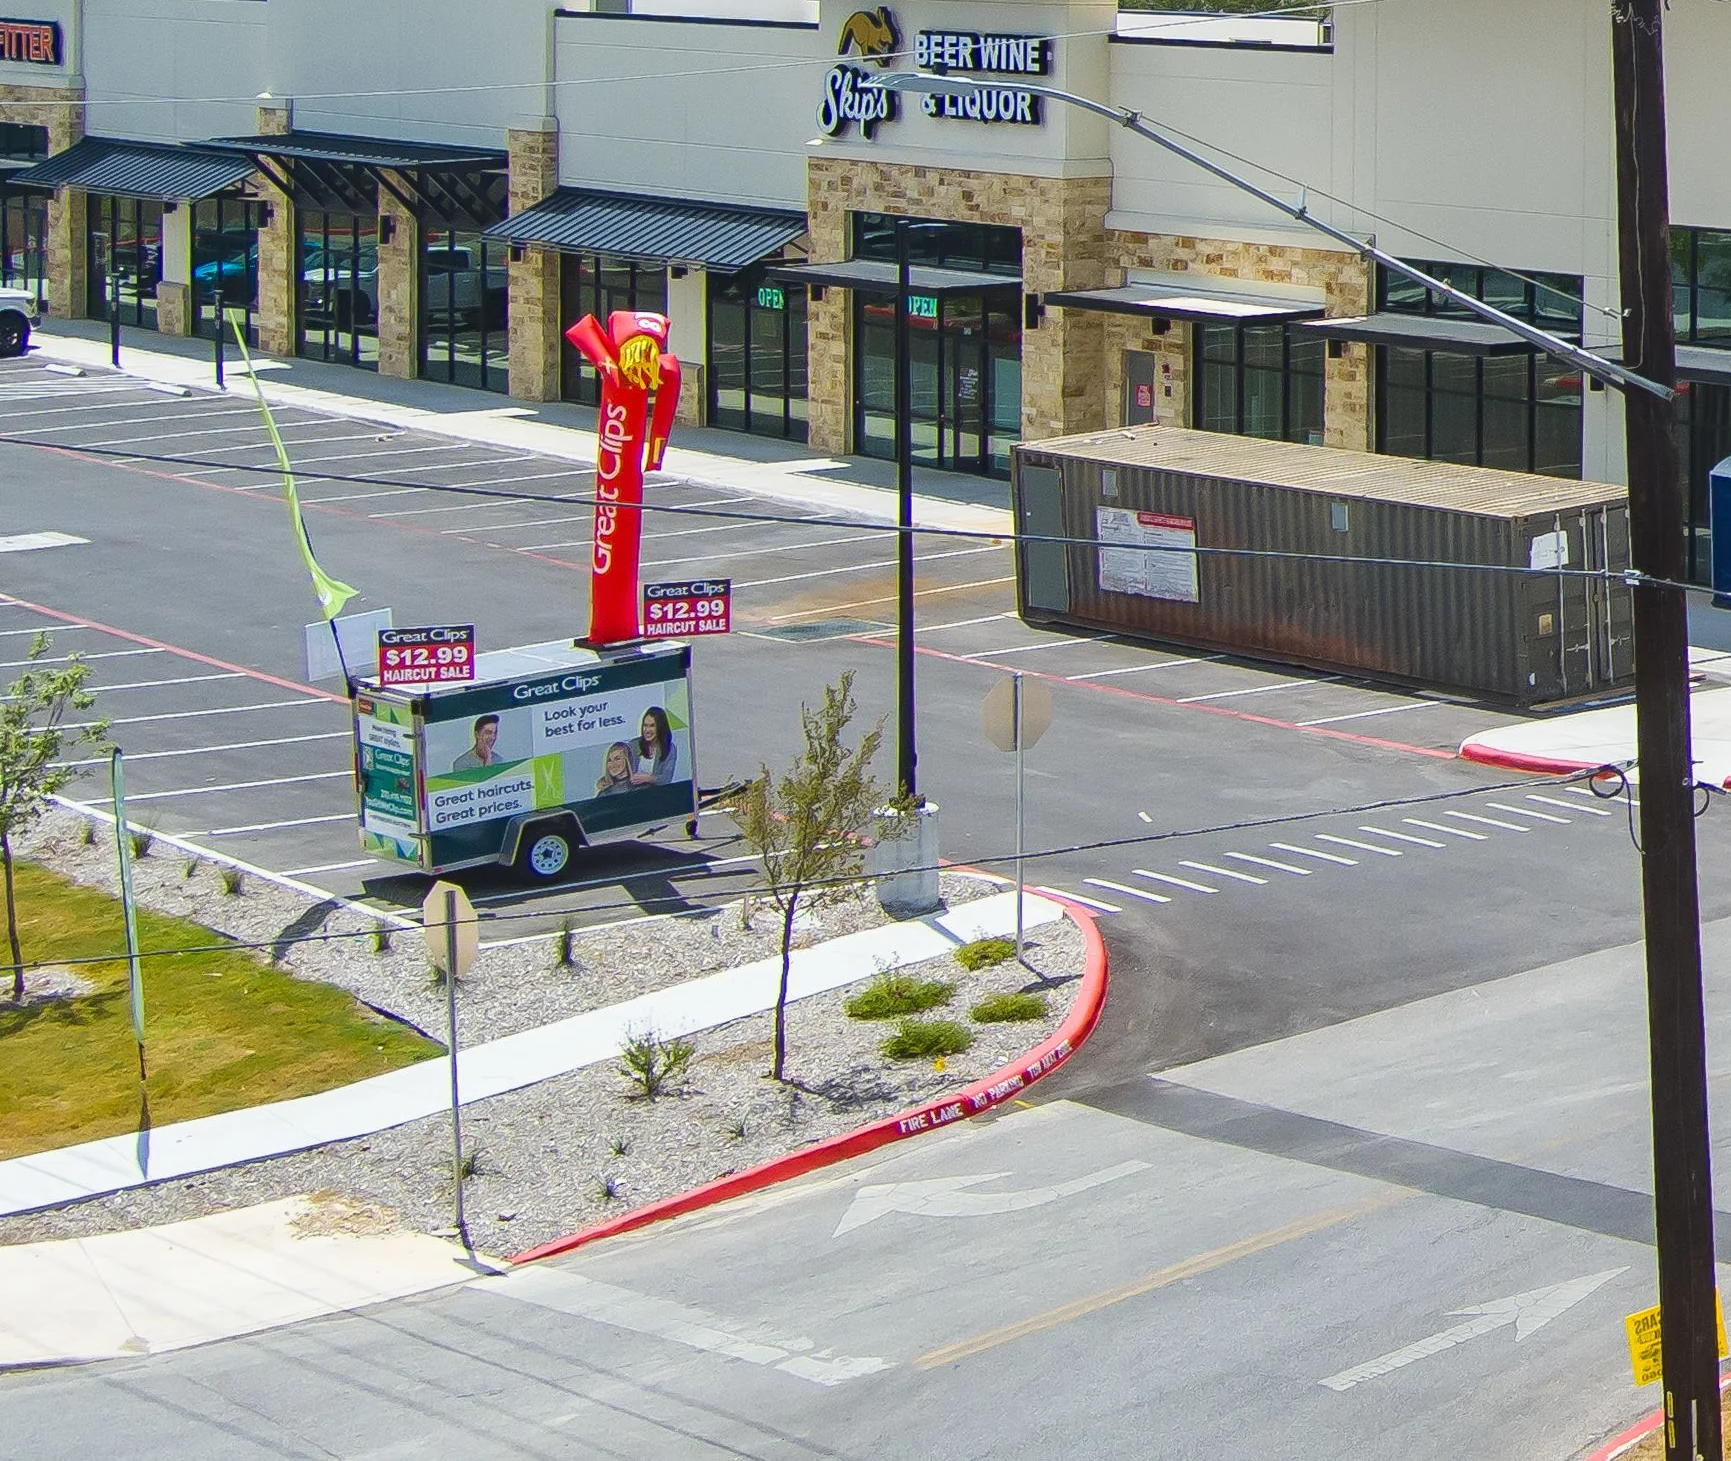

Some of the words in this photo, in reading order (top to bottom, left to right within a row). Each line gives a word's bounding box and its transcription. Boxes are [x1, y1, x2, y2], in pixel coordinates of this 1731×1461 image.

[914, 34, 975, 69] BEER
[979, 37, 1042, 72] WINE
[816, 67, 889, 137] Skip's
[943, 89, 1032, 123] LIQUOR
[757, 288, 785, 310] OPEN
[597, 402, 634, 481] Clips
[592, 485, 620, 575] Great
[647, 585, 689, 598] Great
[690, 582, 725, 596] Clips
[649, 599, 725, 621] $12.99
[381, 630, 428, 643] Great
[429, 628, 468, 643] Clips
[647, 620, 697, 636] HAIRCUT
[698, 618, 727, 632] SALE
[385, 645, 469, 667] $12.99
[383, 667, 438, 682] HAIRCUT
[439, 665, 471, 679] SALE
[513, 682, 560, 699] Great
[561, 675, 600, 692] Clips
[544, 705, 577, 722] Look
[579, 701, 609, 719] your
[545, 722, 575, 738] best
[576, 719, 596, 732] for
[598, 714, 626, 728] less.
[434, 790, 475, 807] Great
[477, 779, 535, 799] haircuts.
[435, 806, 476, 824] Great
[478, 798, 523, 818] prices.
[899, 1114, 930, 1134] FIRE
[930, 1102, 964, 1124] LANE
